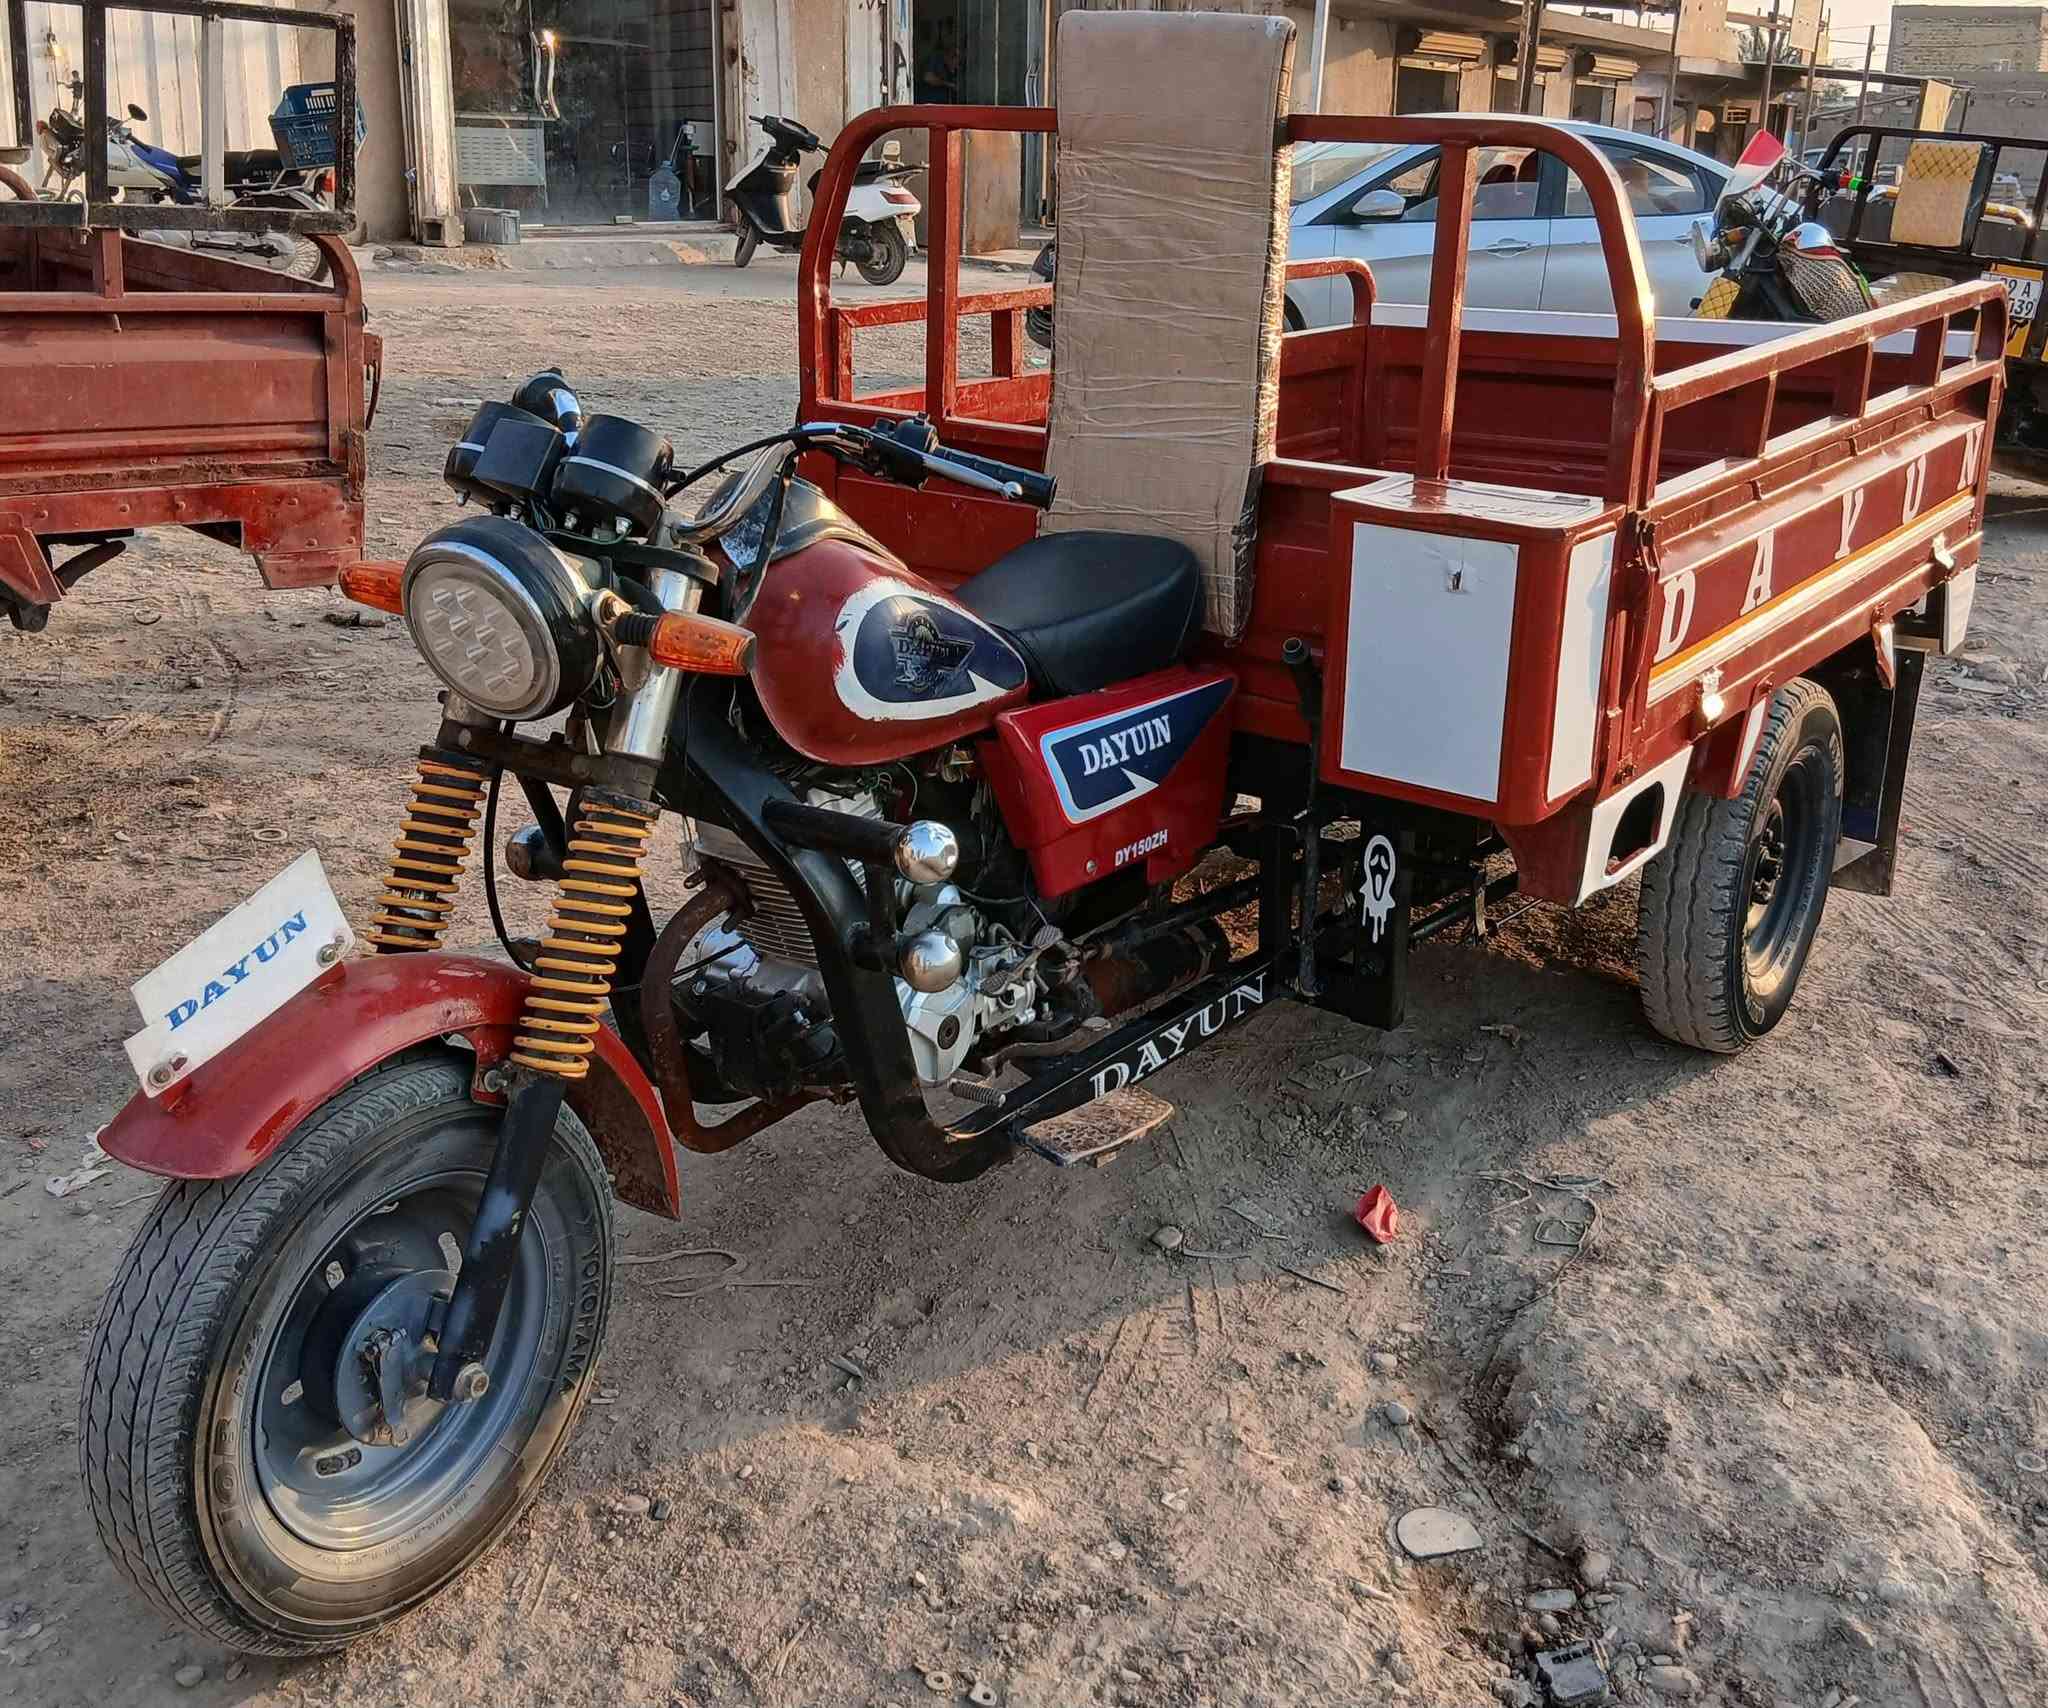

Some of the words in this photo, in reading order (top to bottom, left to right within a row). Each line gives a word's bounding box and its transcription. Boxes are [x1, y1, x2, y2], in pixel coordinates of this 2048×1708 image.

[2021, 281, 2031, 298] A
[1653, 424, 1985, 662] DAYUN
[1115, 829, 1168, 866] DY150ZH
[164, 910, 308, 1032] DAYUN
[1089, 971, 1267, 1100] DAYUN
[559, 1242, 601, 1396] YOKOHAMA
